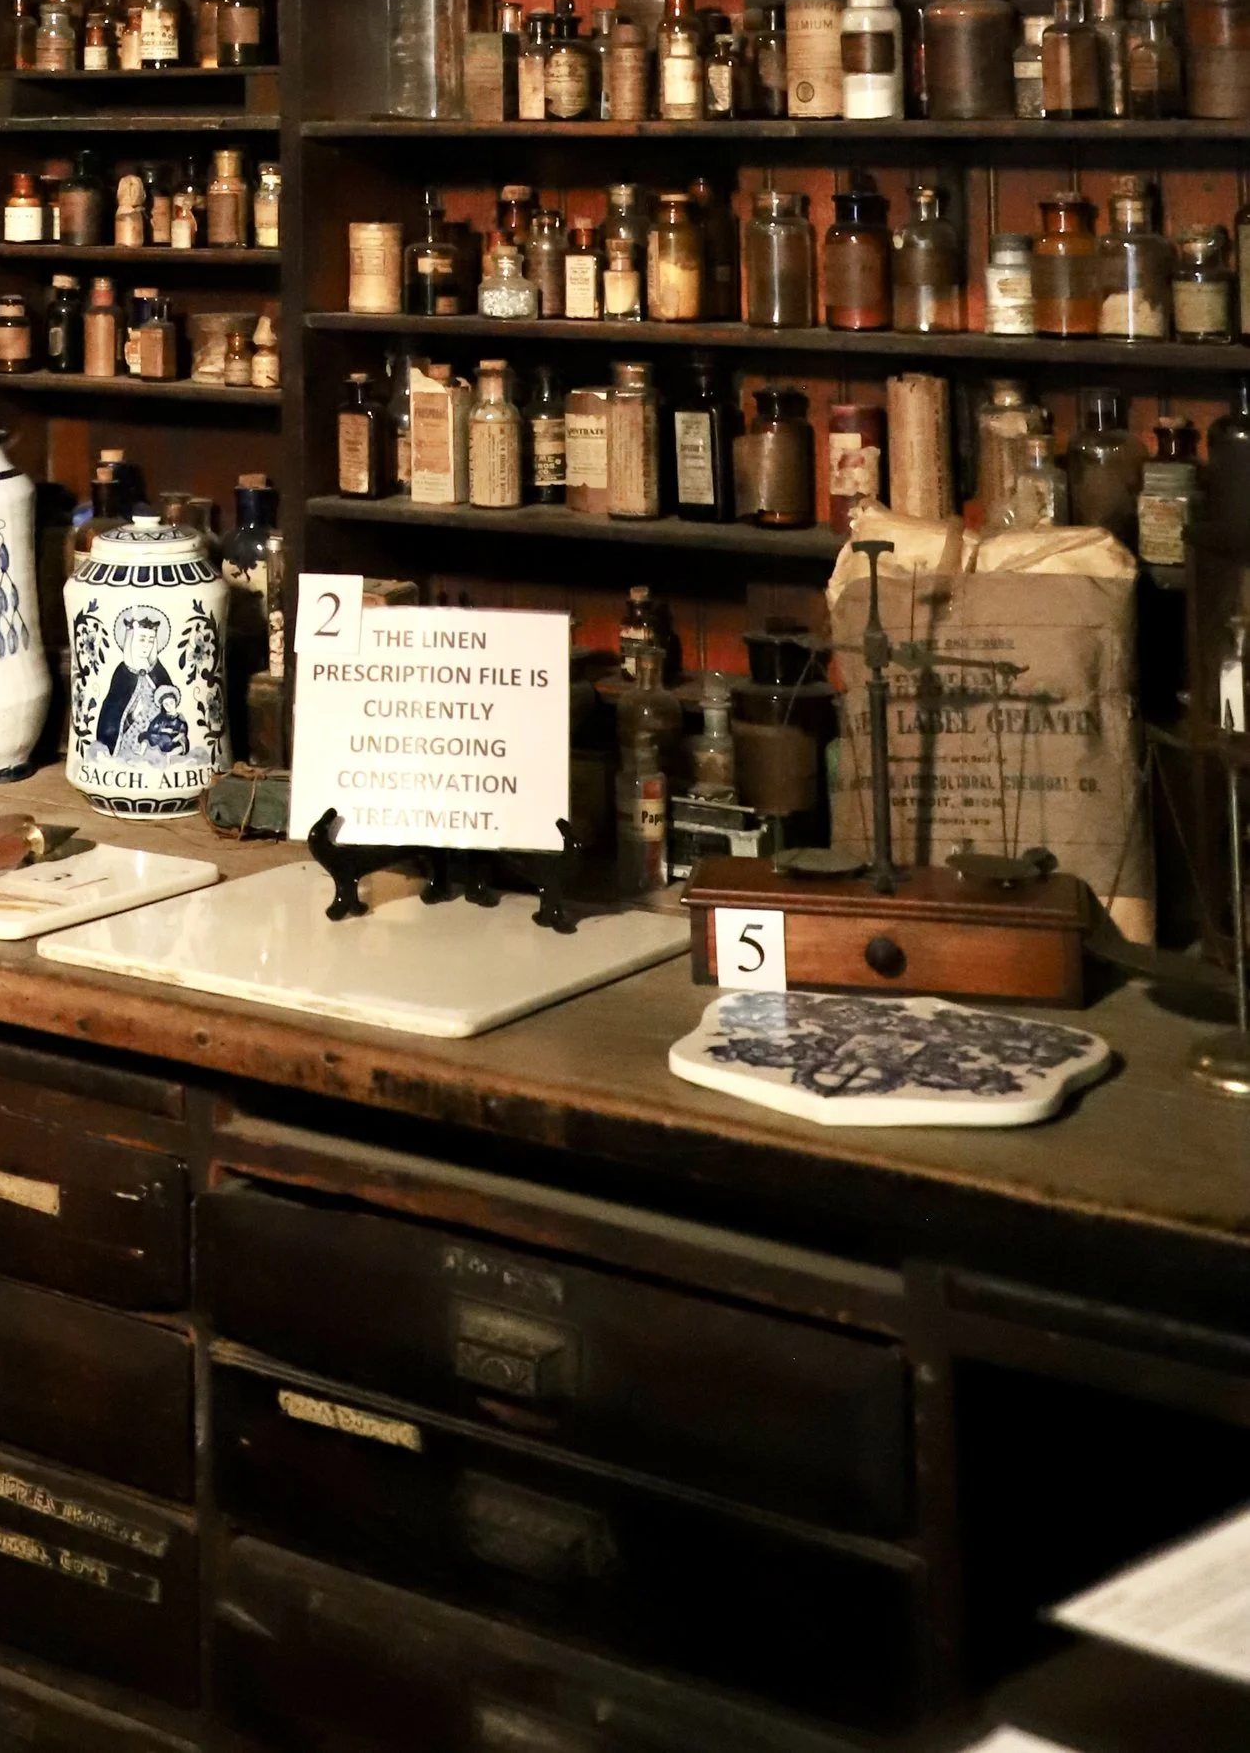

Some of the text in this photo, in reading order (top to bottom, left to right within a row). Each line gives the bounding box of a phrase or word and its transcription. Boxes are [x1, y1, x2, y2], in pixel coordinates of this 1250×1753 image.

[313, 592, 341, 637] 2
[372, 629, 487, 650] THE LINEN
[312, 664, 549, 688] PRESCRIPTION FILE IS
[363, 699, 495, 721] CURRENTLY
[896, 709, 976, 736] LABEL
[986, 709, 1103, 736] GELATIN
[349, 735, 507, 758] UNDERGOING
[78, 765, 149, 790] SACCH.
[337, 769, 518, 794] CONSERVATION
[1078, 777, 1102, 793] CO.
[352, 806, 499, 831] TREATMENT.
[738, 923, 765, 973] 5
